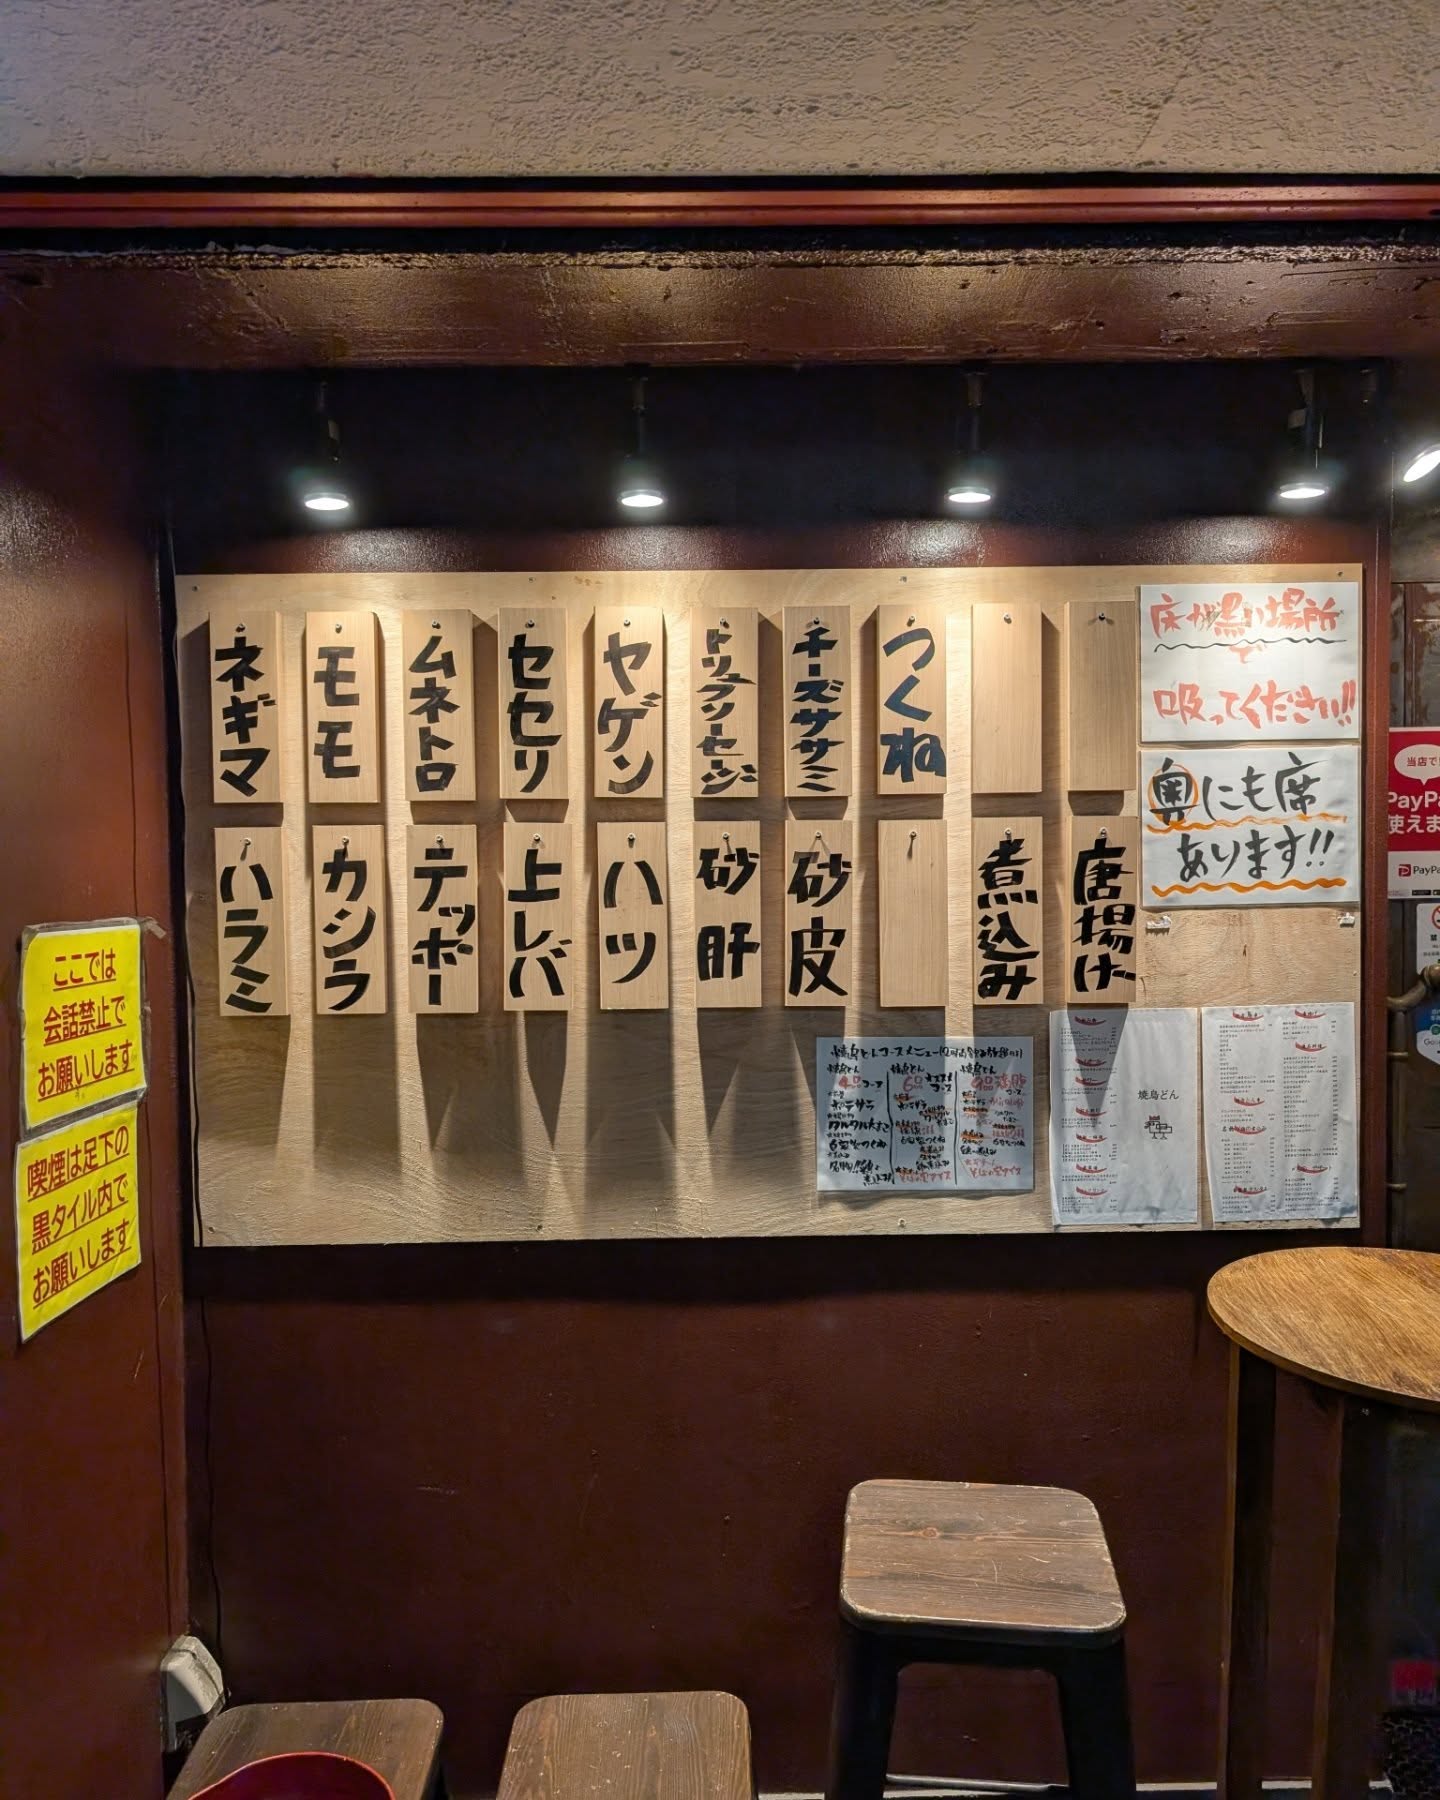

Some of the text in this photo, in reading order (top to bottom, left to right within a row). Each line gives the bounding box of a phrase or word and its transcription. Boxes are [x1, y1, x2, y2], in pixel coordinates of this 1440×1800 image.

[214, 637, 277, 797] ネギマ
[313, 646, 361, 778] モモ
[408, 635, 461, 793] ムネトロ
[507, 633, 562, 793] セセリ
[597, 631, 663, 794] ヤゲン
[696, 628, 758, 795] トリュフソーセージ
[789, 627, 845, 792] チーズササミ
[880, 627, 947, 783] つくね
[1406, 757, 1440, 767] 当店で
[1150, 751, 1329, 825] 奥にも席
[1177, 825, 1335, 882] あります!!
[1388, 790, 1440, 813] PayP
[53, 948, 117, 987] ここでは
[219, 863, 274, 1013] ハラミ
[322, 848, 376, 1010] カシラ
[411, 848, 475, 1006] テッポー
[507, 848, 573, 998] 上レバ
[603, 860, 663, 984] ハツ
[696, 847, 761, 981] 砂肝
[787, 850, 852, 996] 砂皮
[977, 838, 1040, 1000] 煮込み
[1072, 838, 1137, 992] 唐揚げ
[37, 1039, 133, 1098] お願いします
[43, 995, 126, 1044] 会話禁止で
[27, 1125, 129, 1199] 喫煙は足下の
[32, 1173, 128, 1252] 黒タイル内で
[32, 1218, 130, 1305] お願いします
